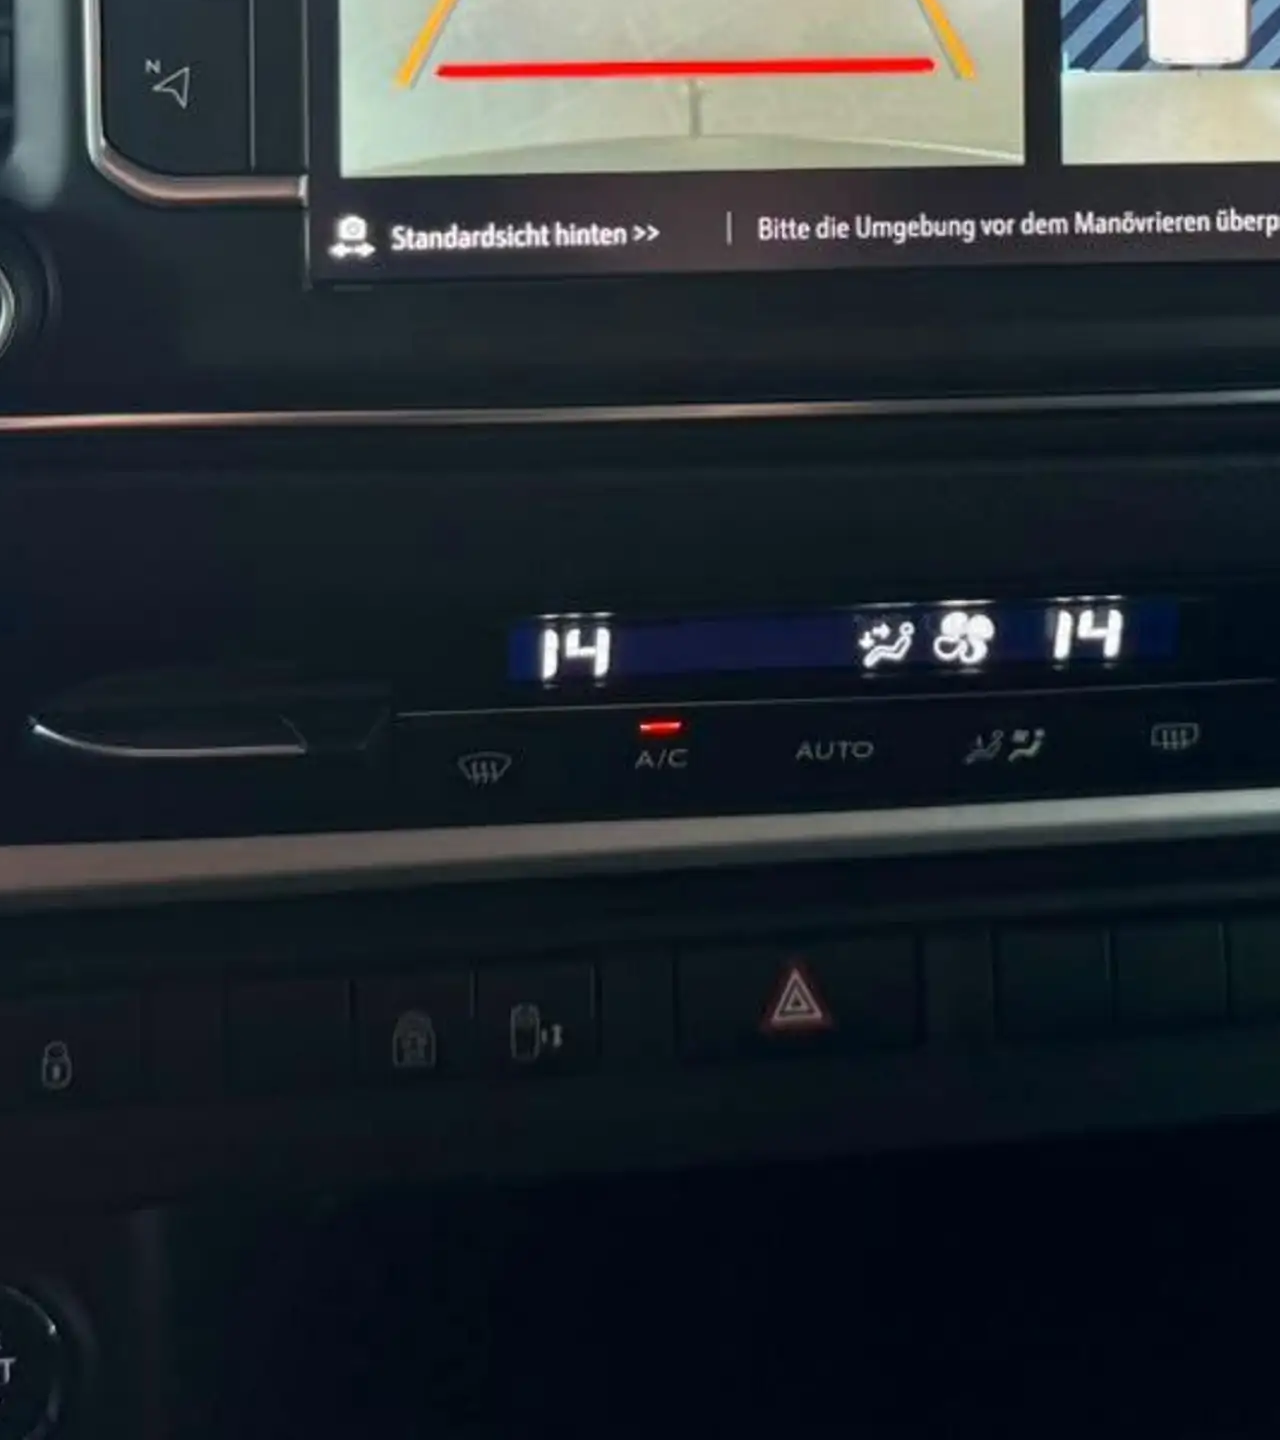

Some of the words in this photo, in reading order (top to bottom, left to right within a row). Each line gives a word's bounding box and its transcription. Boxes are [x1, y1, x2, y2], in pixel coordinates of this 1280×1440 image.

[391, 222, 550, 251] Standardsicht
[555, 221, 627, 247] hinten
[758, 215, 811, 241] Bitte
[815, 214, 850, 240] die
[855, 212, 976, 244] Umgebung
[980, 217, 1017, 236] vor
[1020, 210, 1069, 235] dem
[1074, 211, 1210, 235] Manövrieren
[1051, 608, 1124, 659] 14
[542, 626, 611, 679] 14
[635, 747, 688, 770] A/C
[795, 739, 876, 763] AUTO
